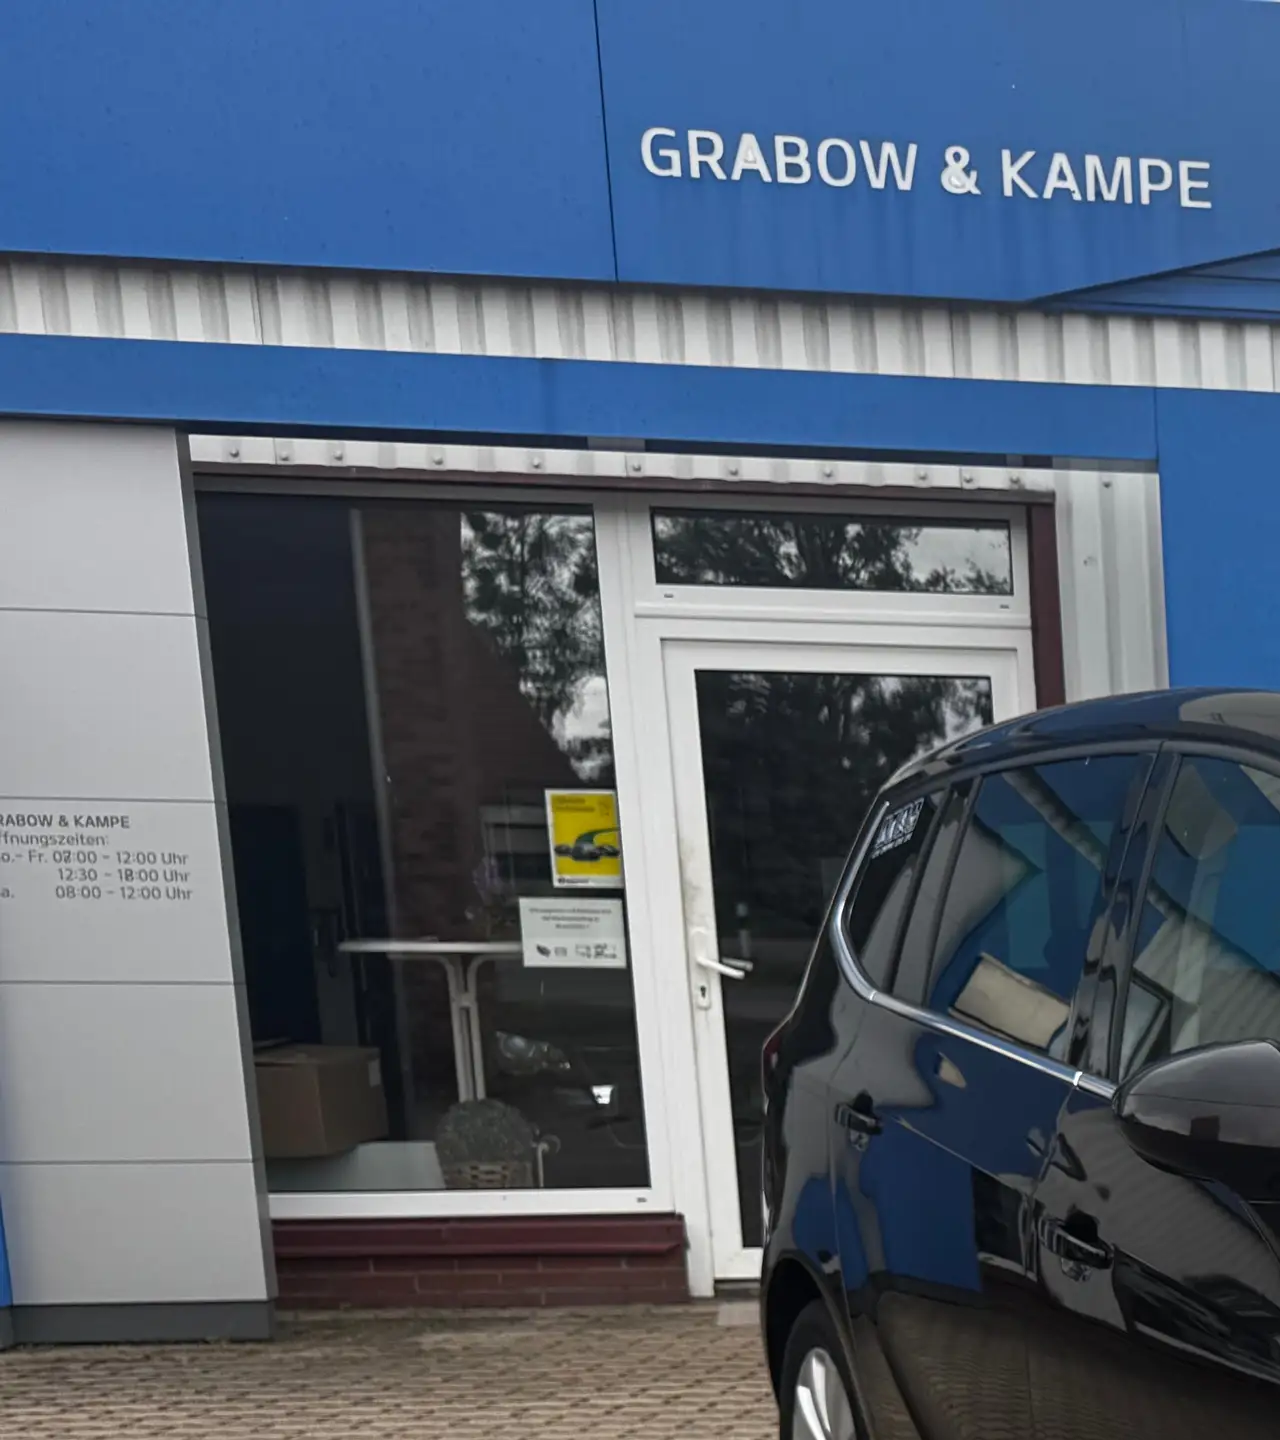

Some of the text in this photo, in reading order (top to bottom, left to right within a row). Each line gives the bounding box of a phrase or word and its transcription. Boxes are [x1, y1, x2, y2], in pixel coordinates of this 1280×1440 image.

[640, 127, 1212, 209] GRABOW & KAMPE
[58, 814, 69, 828] &
[74, 815, 131, 829] KAMPE
[116, 851, 157, 865] 12:00
[161, 852, 189, 865] Uhr
[58, 868, 98, 882] 12:30
[163, 869, 190, 883] Uhr
[55, 885, 101, 899] 08:00
[120, 886, 161, 900] 12:00
[166, 887, 193, 900] Uhr
